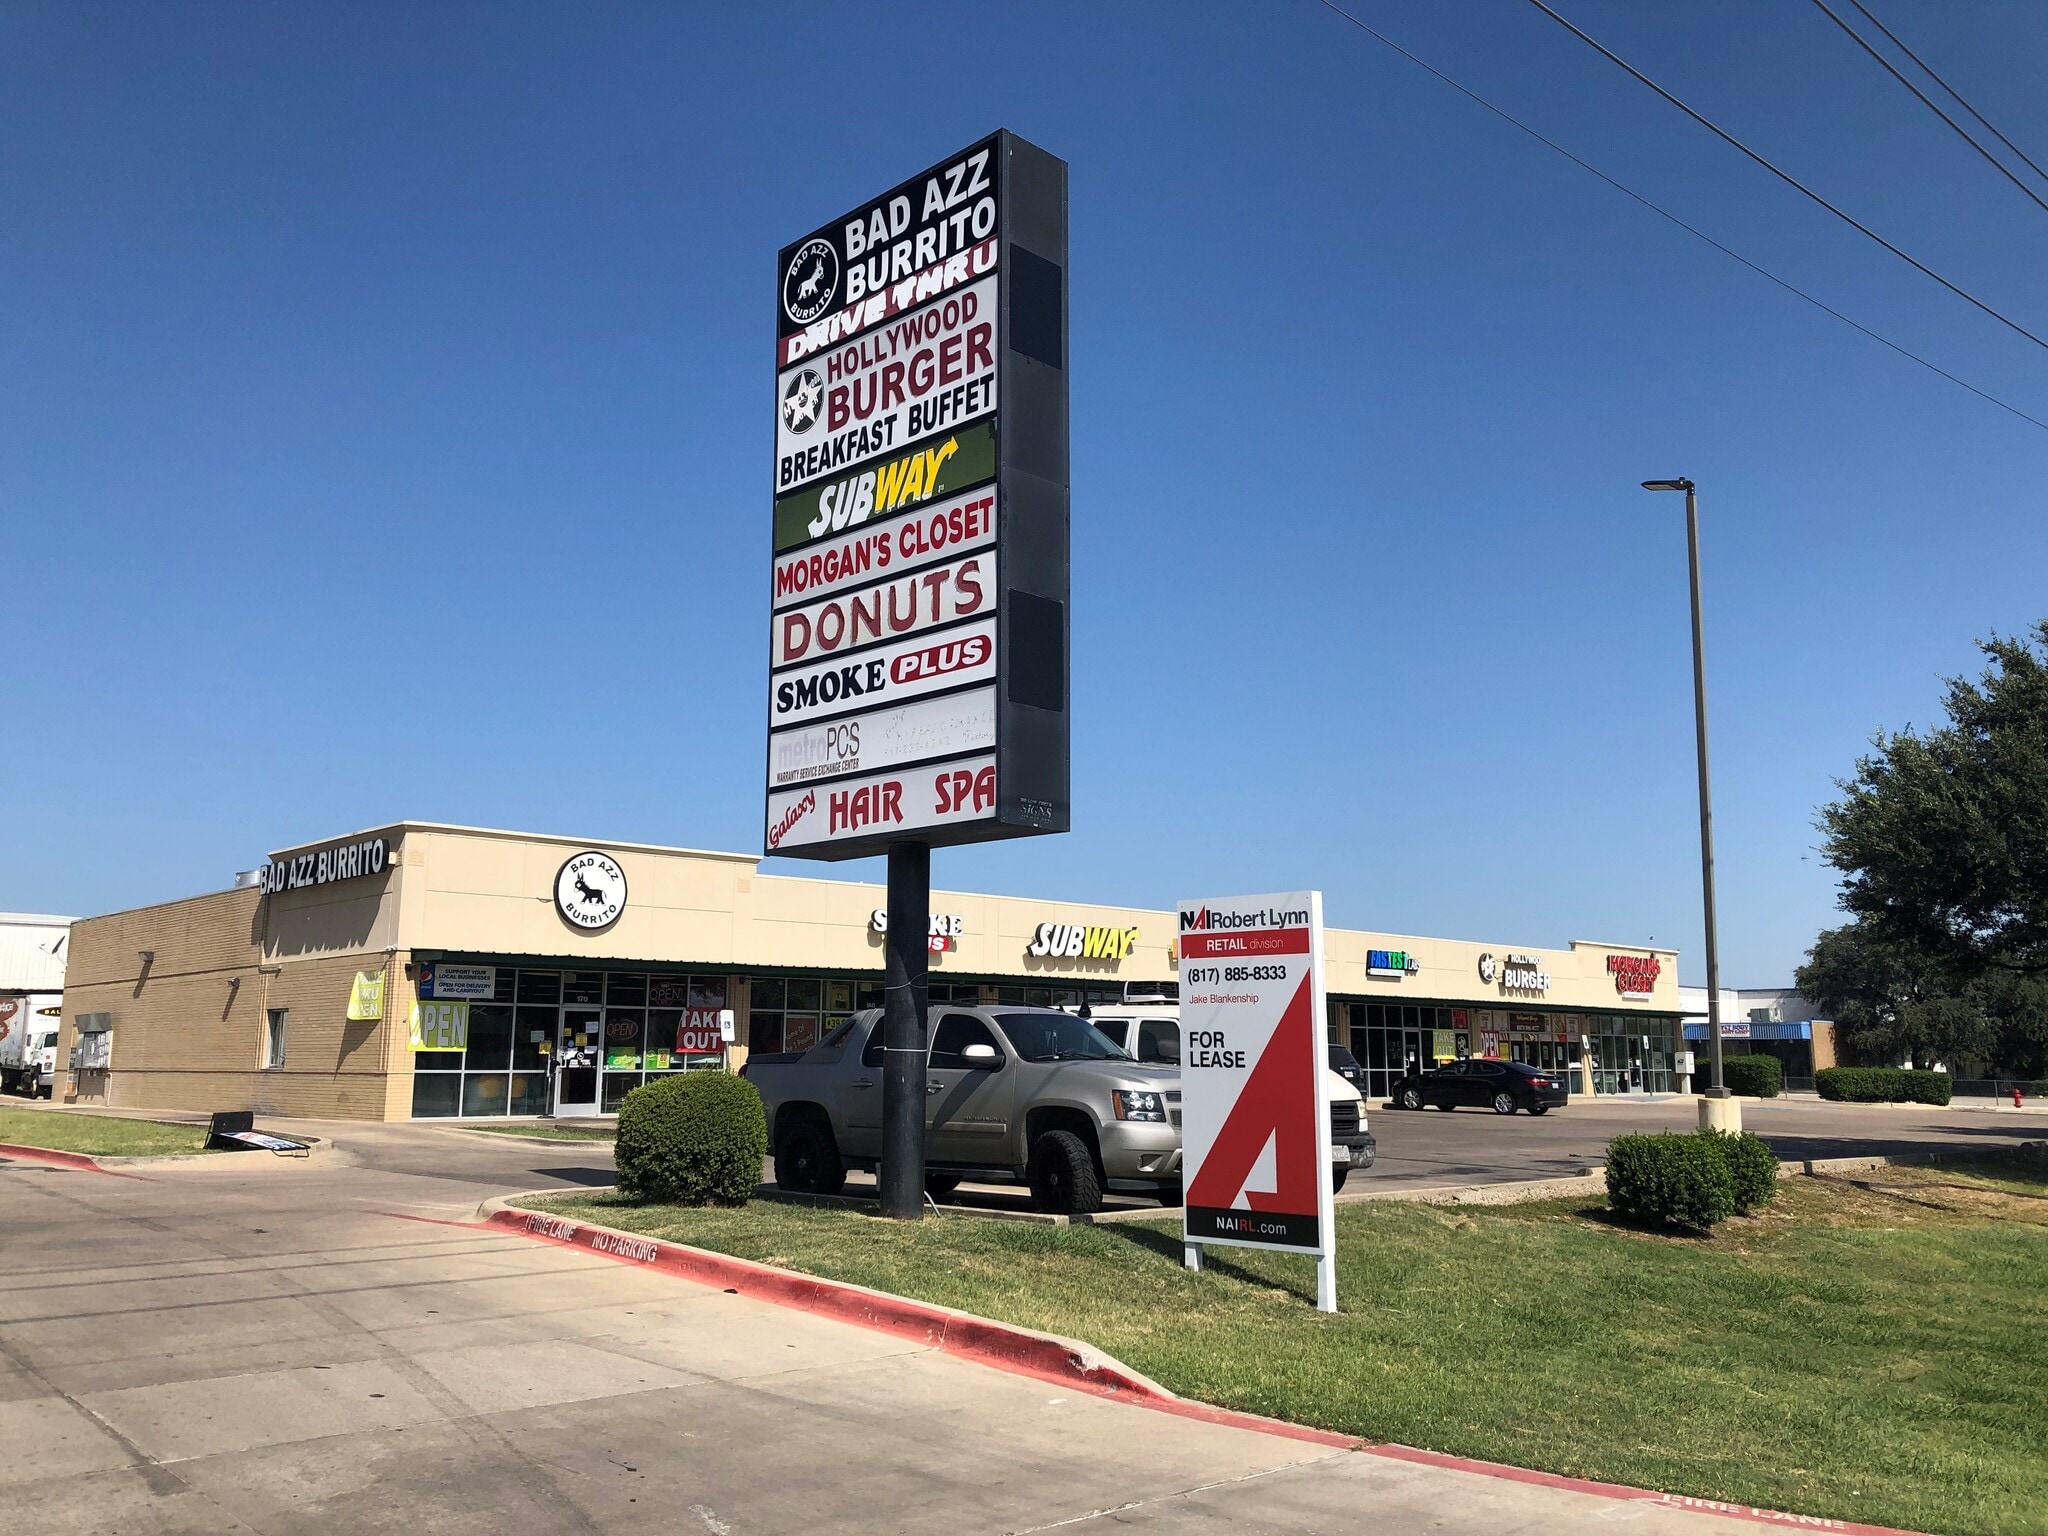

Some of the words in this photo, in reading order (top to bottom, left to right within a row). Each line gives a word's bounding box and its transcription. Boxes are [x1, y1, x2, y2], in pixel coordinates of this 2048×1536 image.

[845, 195, 911, 261] BAD
[921, 148, 990, 222] AZZ
[791, 250, 808, 276] BAD
[811, 244, 829, 258] AZZ
[846, 196, 997, 304] BURRITO
[790, 288, 831, 319] BURRITO
[827, 291, 978, 384] HOLLYWOOD
[827, 322, 994, 433] BURGER
[780, 413, 898, 487] BREAKFAST
[908, 372, 995, 438] BUFFET
[807, 434, 960, 539] SUBWAY
[776, 533, 892, 598] MORGAN'S
[898, 495, 995, 559] CLOSET
[783, 559, 984, 661] DONUTS
[776, 658, 886, 713] SMOKE
[898, 638, 984, 681] PLUS
[776, 769, 799, 783] WARRANTY
[800, 765, 818, 779] SERVICE
[818, 761, 842, 776] EXCHANGE
[841, 757, 860, 771] CENTER
[768, 789, 816, 848] Galaxy
[829, 780, 904, 836] HAIR
[934, 764, 996, 814] SPA
[260, 860, 285, 895] BAD
[287, 853, 315, 890] AZZ
[317, 838, 384, 884] BURRITO
[570, 857, 595, 873] BAD
[598, 861, 619, 882] AZZ
[565, 902, 617, 924] BURRITO
[873, 909, 963, 936] SKE
[1269, 908, 1309, 929] Lynn
[1030, 922, 1142, 960] SUBWAY
[1206, 938, 1248, 951] RETAIL
[1249, 937, 1284, 950] division
[1370, 951, 1409, 970] FASTEST
[1187, 967, 1220, 986] (817)
[1224, 965, 1287, 982] 885-8333
[1504, 968, 1551, 990] BURGER
[1617, 973, 1657, 993] CLOSET
[1189, 994, 1208, 1005] Jake
[1209, 993, 1259, 1006] Blankenship
[410, 1004, 467, 1047] OPEN
[1433, 1032, 1456, 1043] TAKE
[683, 1031, 721, 1049] OUT
[1189, 1031, 1225, 1049] FOR
[1436, 1045, 1453, 1055] OUT
[1480, 1032, 1500, 1057] OPEN
[1189, 1050, 1246, 1068] LEASE
[526, 1214, 551, 1237] FIRE
[549, 1219, 577, 1242] LANE
[1216, 1216, 1287, 1235] NAIRL.com
[591, 1231, 611, 1249] NO
[609, 1234, 658, 1262] PARKING
[1663, 1493, 1740, 1514] FIRE
[1751, 1507, 1846, 1530] LANE
